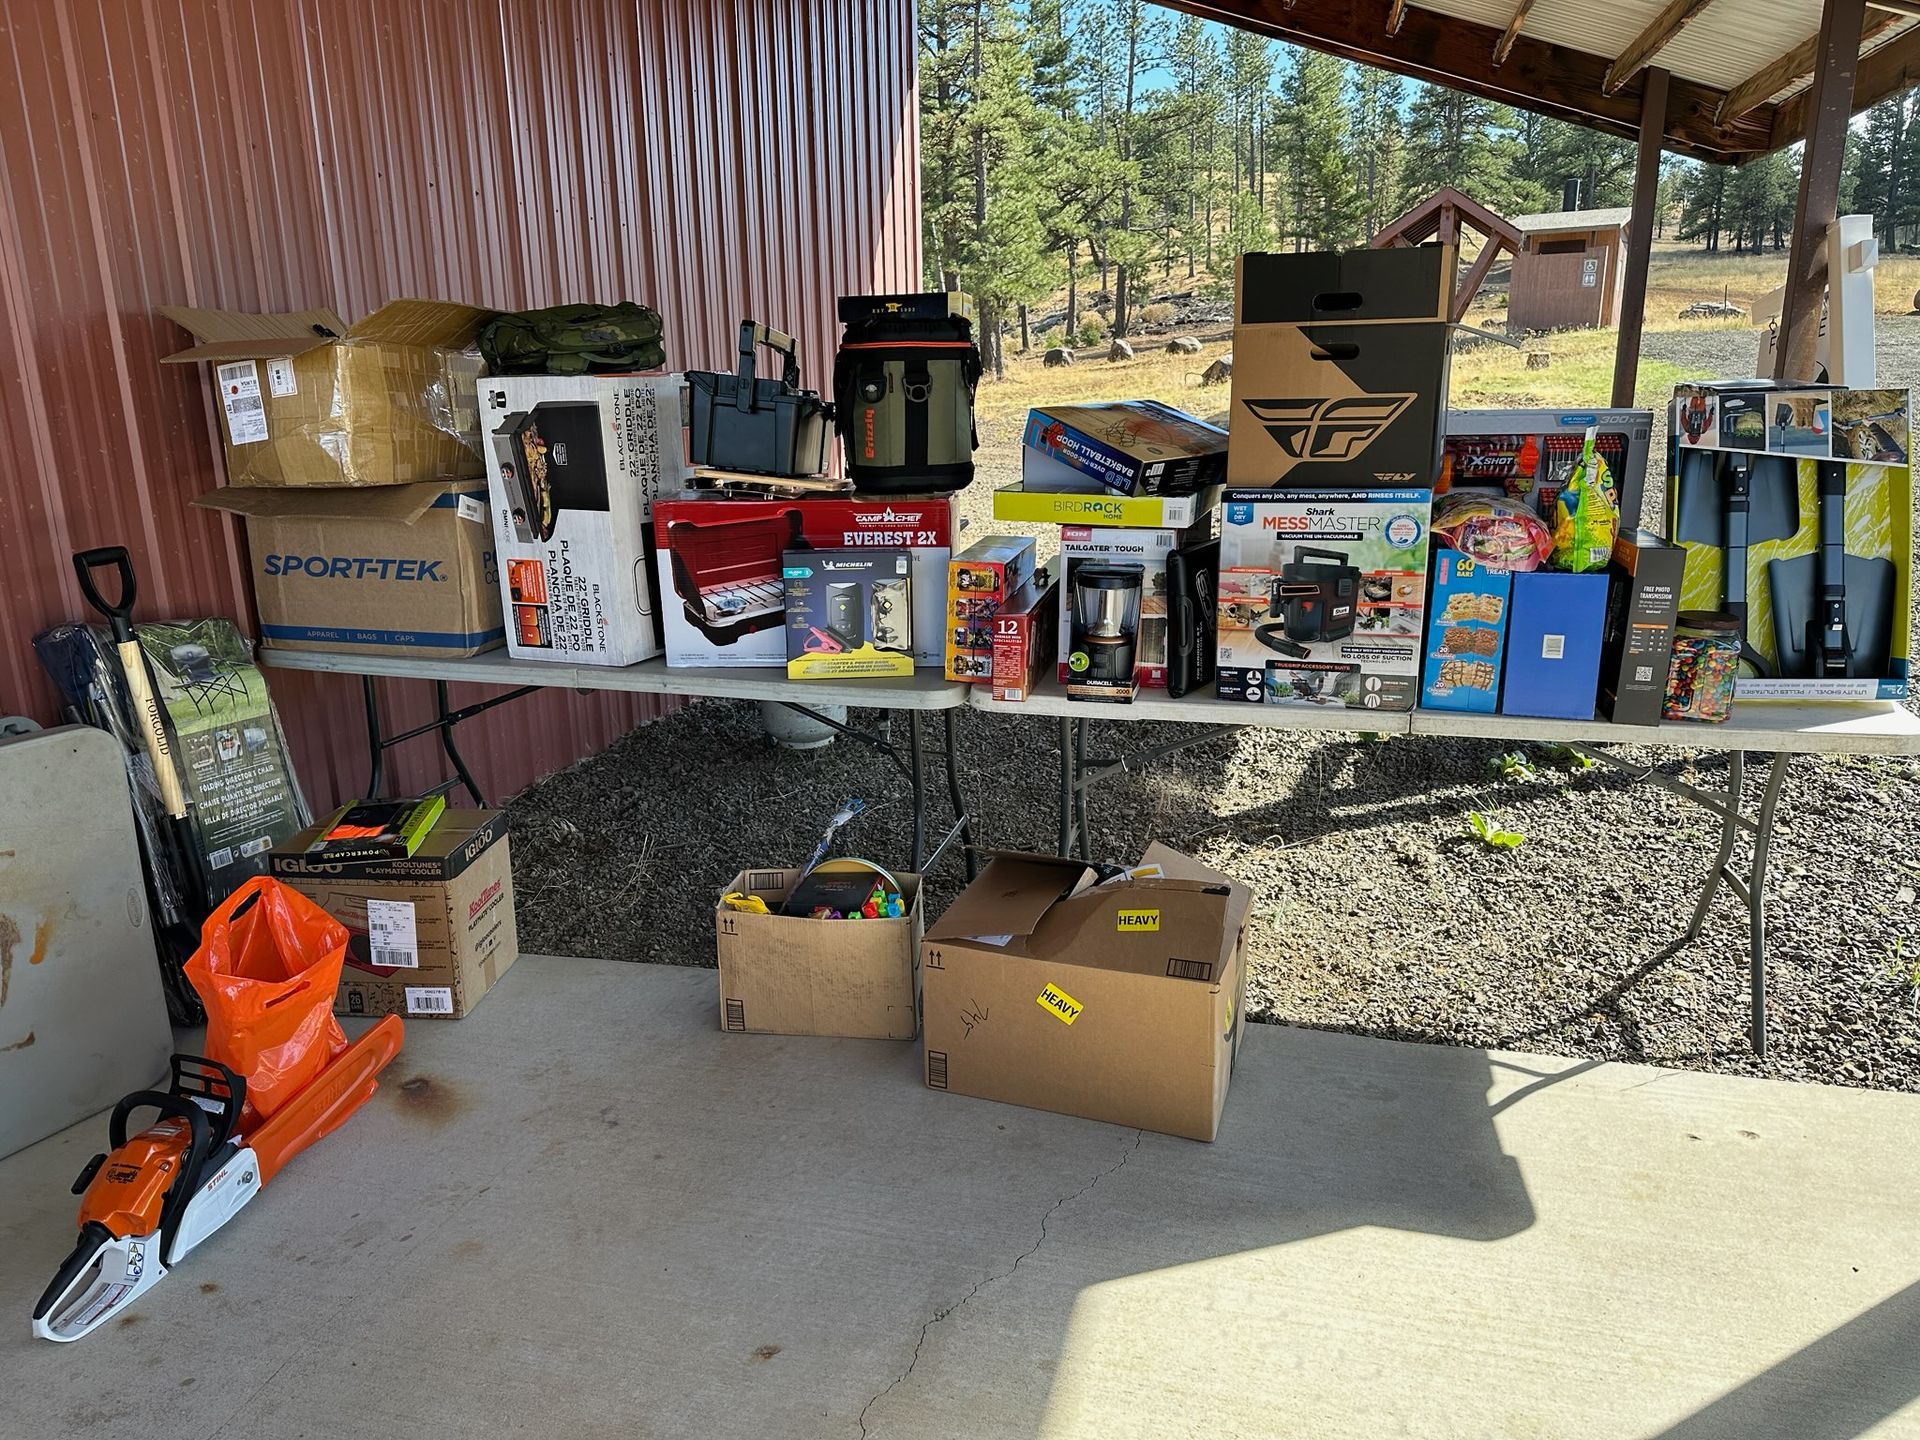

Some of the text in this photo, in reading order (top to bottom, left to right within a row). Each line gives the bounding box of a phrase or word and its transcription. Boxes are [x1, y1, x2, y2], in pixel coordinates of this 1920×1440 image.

[613, 388, 625, 470] BLACKSTONE
[624, 388, 634, 452] GRIDDLE
[647, 410, 653, 428] DE
[864, 409, 874, 458] Grizzly
[635, 388, 650, 515] PLAQUE DE 22 PO
[1056, 433, 1134, 477] BASKETBALL HOOP
[1104, 470, 1131, 490] LED
[1054, 501, 1122, 513] BIRDROCK
[1263, 517, 1380, 531] MESSMASTER
[844, 531, 936, 545] EVEREST 2X
[1457, 558, 1475, 571] 60
[548, 550, 567, 655] PLANCHA DE 22"
[560, 540, 580, 651] PLAQUE DE 22 PO
[578, 576, 594, 652] 22" GRIDDLE
[592, 584, 606, 653] BLACKSTONE
[998, 620, 1018, 634] 12
[1896, 684, 1903, 694] 2
[146, 696, 169, 756] FORCOLID
[200, 765, 274, 792] FOLDING CHAIR
[253, 778, 281, 792] DIRECTEUR
[204, 815, 220, 825] SILLA
[230, 801, 257, 814] DIRECTOR
[259, 793, 283, 806] PLEGABLE
[334, 849, 379, 858] POWERCAP
[465, 829, 492, 862] IGLOO
[1118, 916, 1158, 926] HEAVY
[350, 994, 361, 1004] 26
[1040, 989, 1079, 1018] HEAVY
[207, 1170, 229, 1191] STIHL
